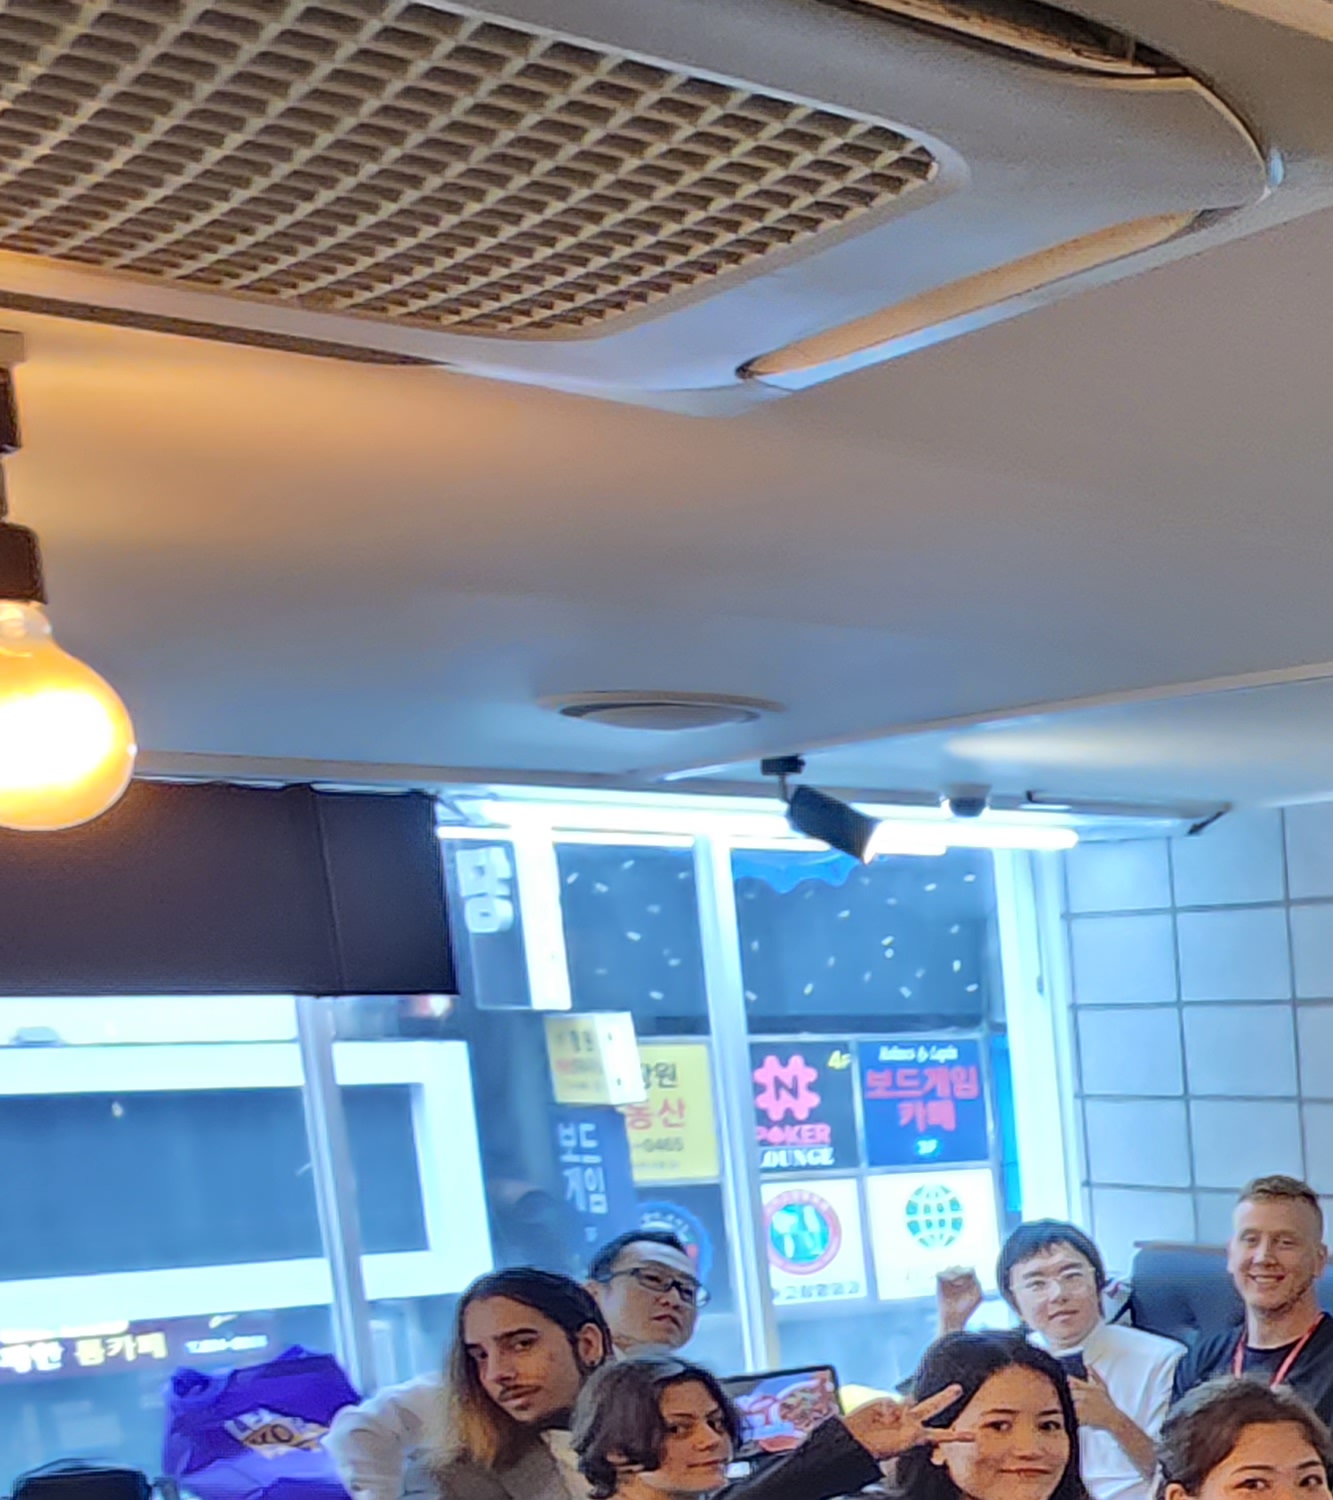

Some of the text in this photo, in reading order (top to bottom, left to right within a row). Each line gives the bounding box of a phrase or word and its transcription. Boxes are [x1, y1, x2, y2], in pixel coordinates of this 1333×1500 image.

[864, 1066, 979, 1100] 보드게임
[898, 1100, 956, 1132] 카페
[558, 1123, 601, 1163] 보드
[563, 1166, 608, 1214] 게임
